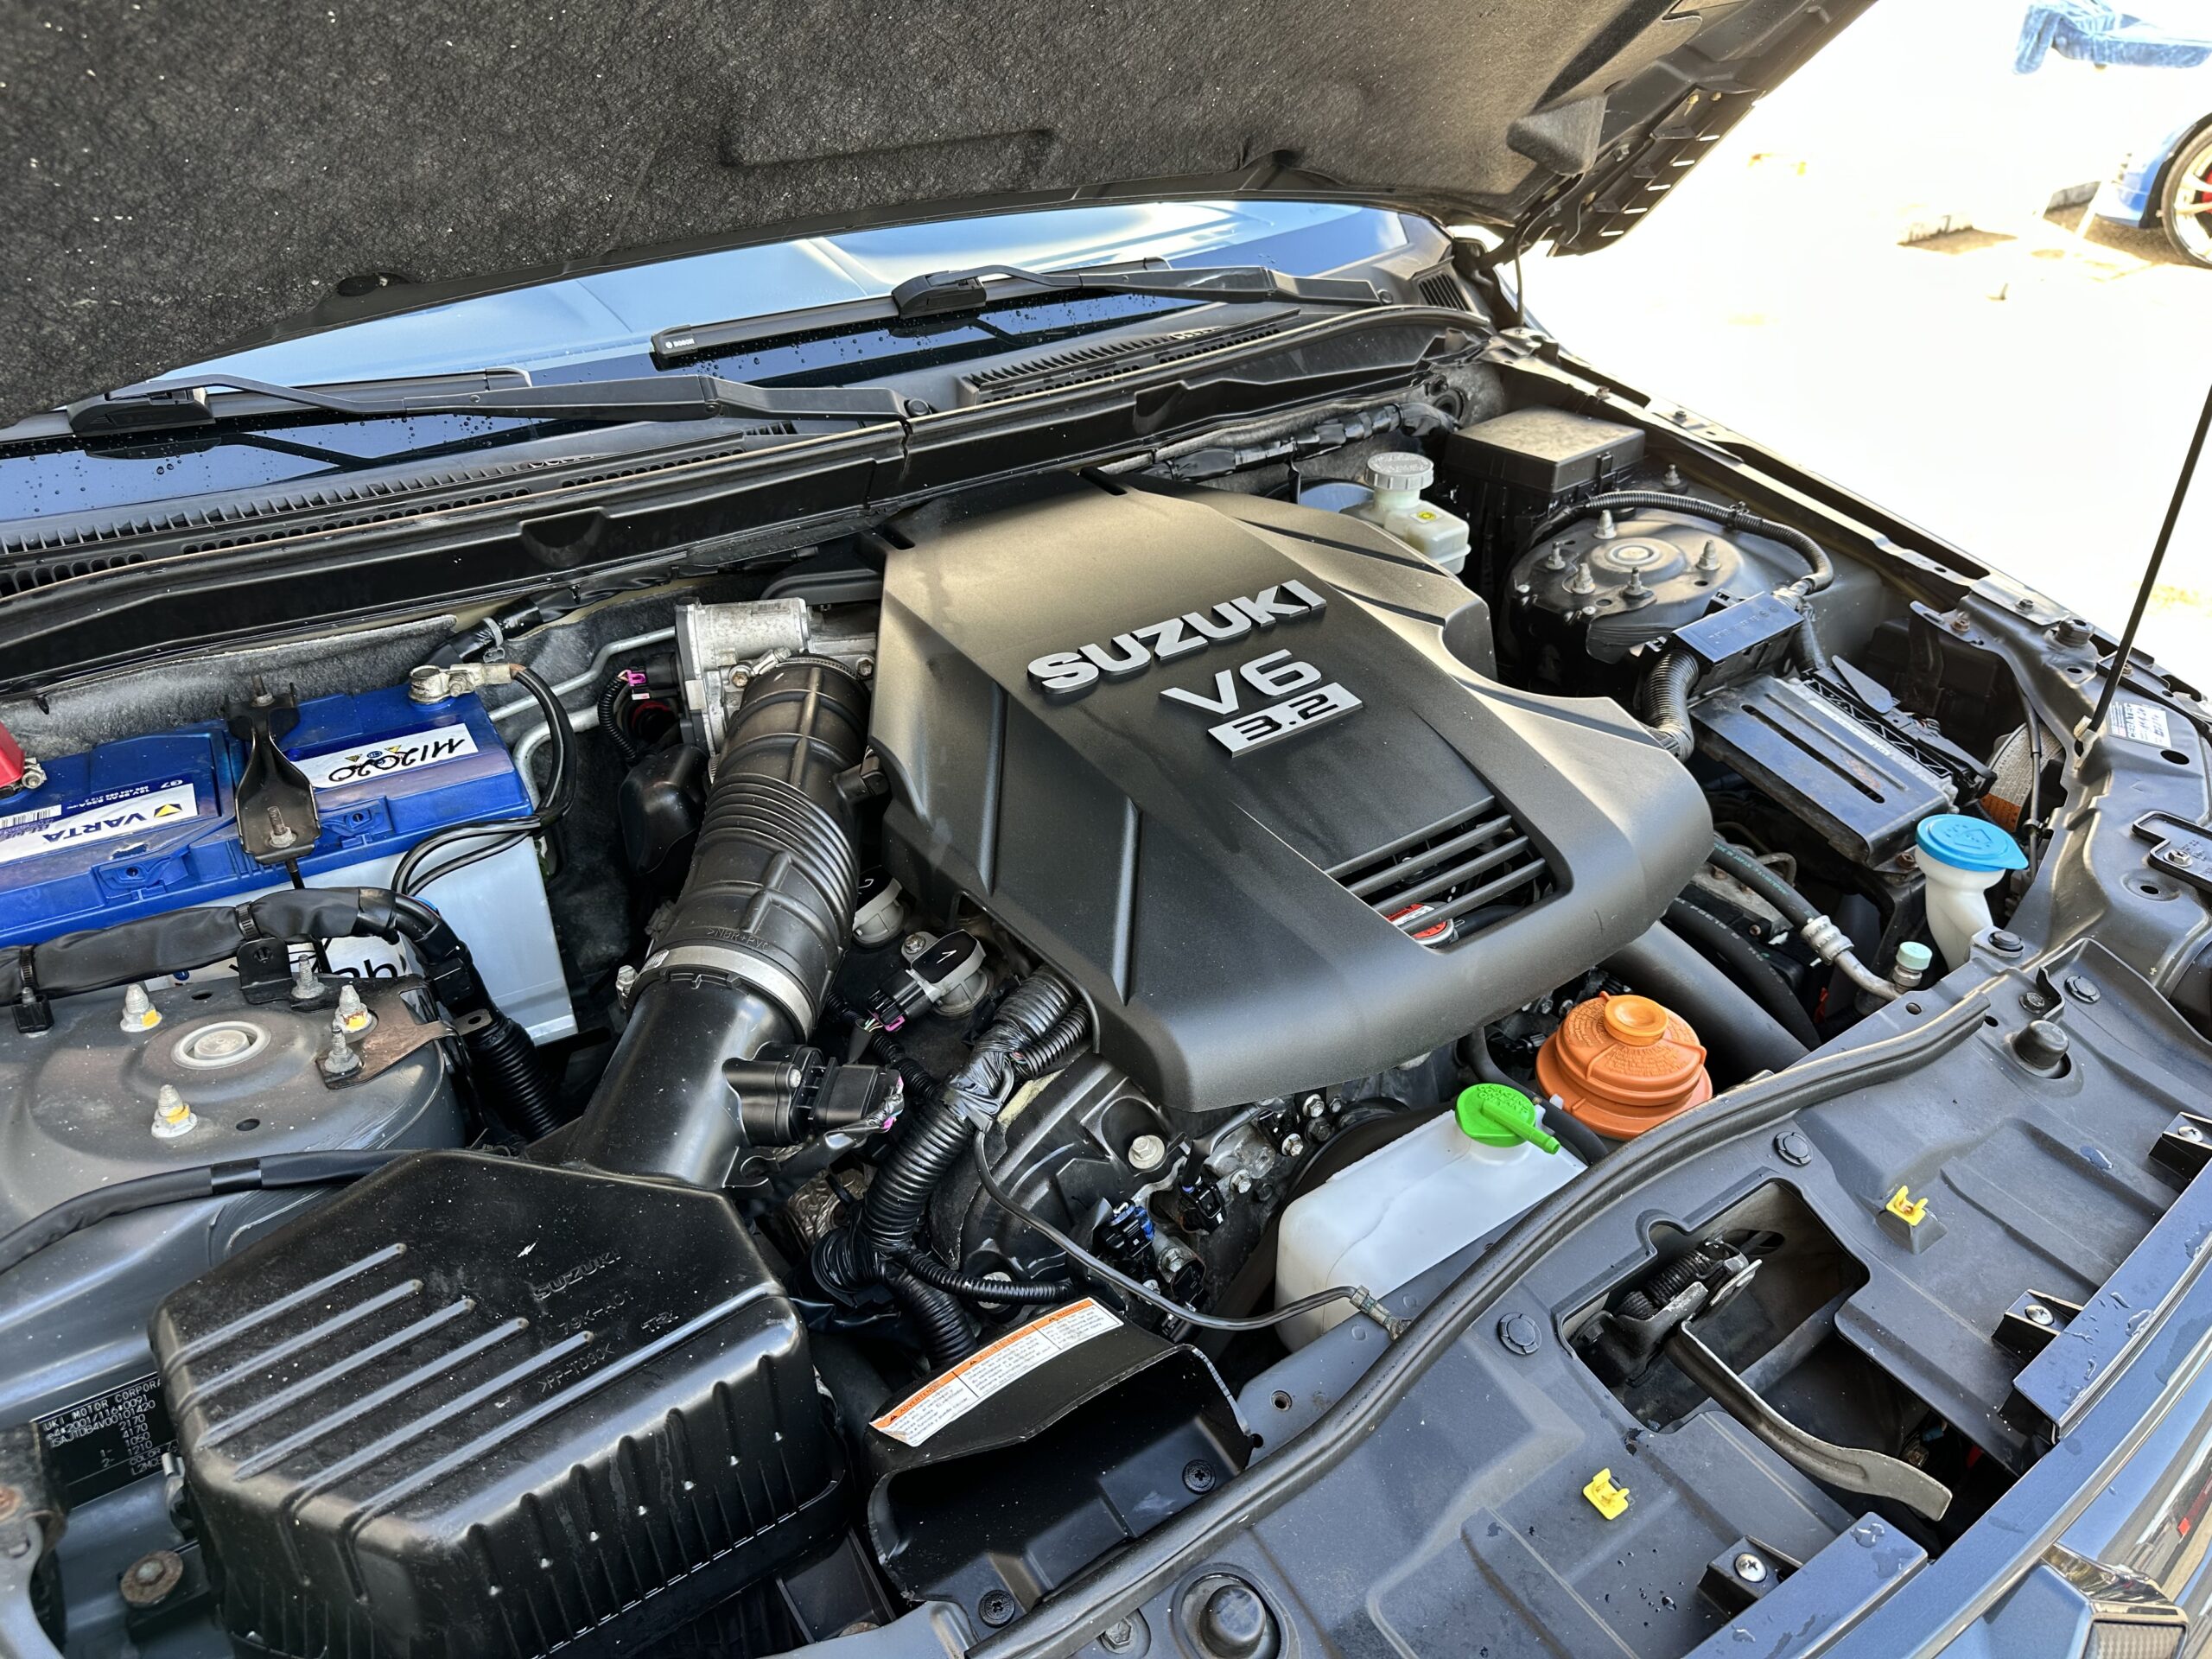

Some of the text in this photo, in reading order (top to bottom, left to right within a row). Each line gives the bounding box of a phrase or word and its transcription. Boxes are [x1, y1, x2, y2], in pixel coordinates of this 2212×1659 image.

[1027, 579, 1327, 694] SUZUKI
[1158, 648, 1322, 716] V6
[1233, 692, 1339, 741] 3.2
[41, 812, 147, 843] VARTA
[532, 1248, 621, 1300] SUZUKI
[71, 1398, 110, 1420] MOTOR
[118, 1413, 147, 1431] 2170
[122, 1422, 149, 1440] 4170
[124, 1431, 151, 1447] 1050
[127, 1440, 153, 1457] 1210
